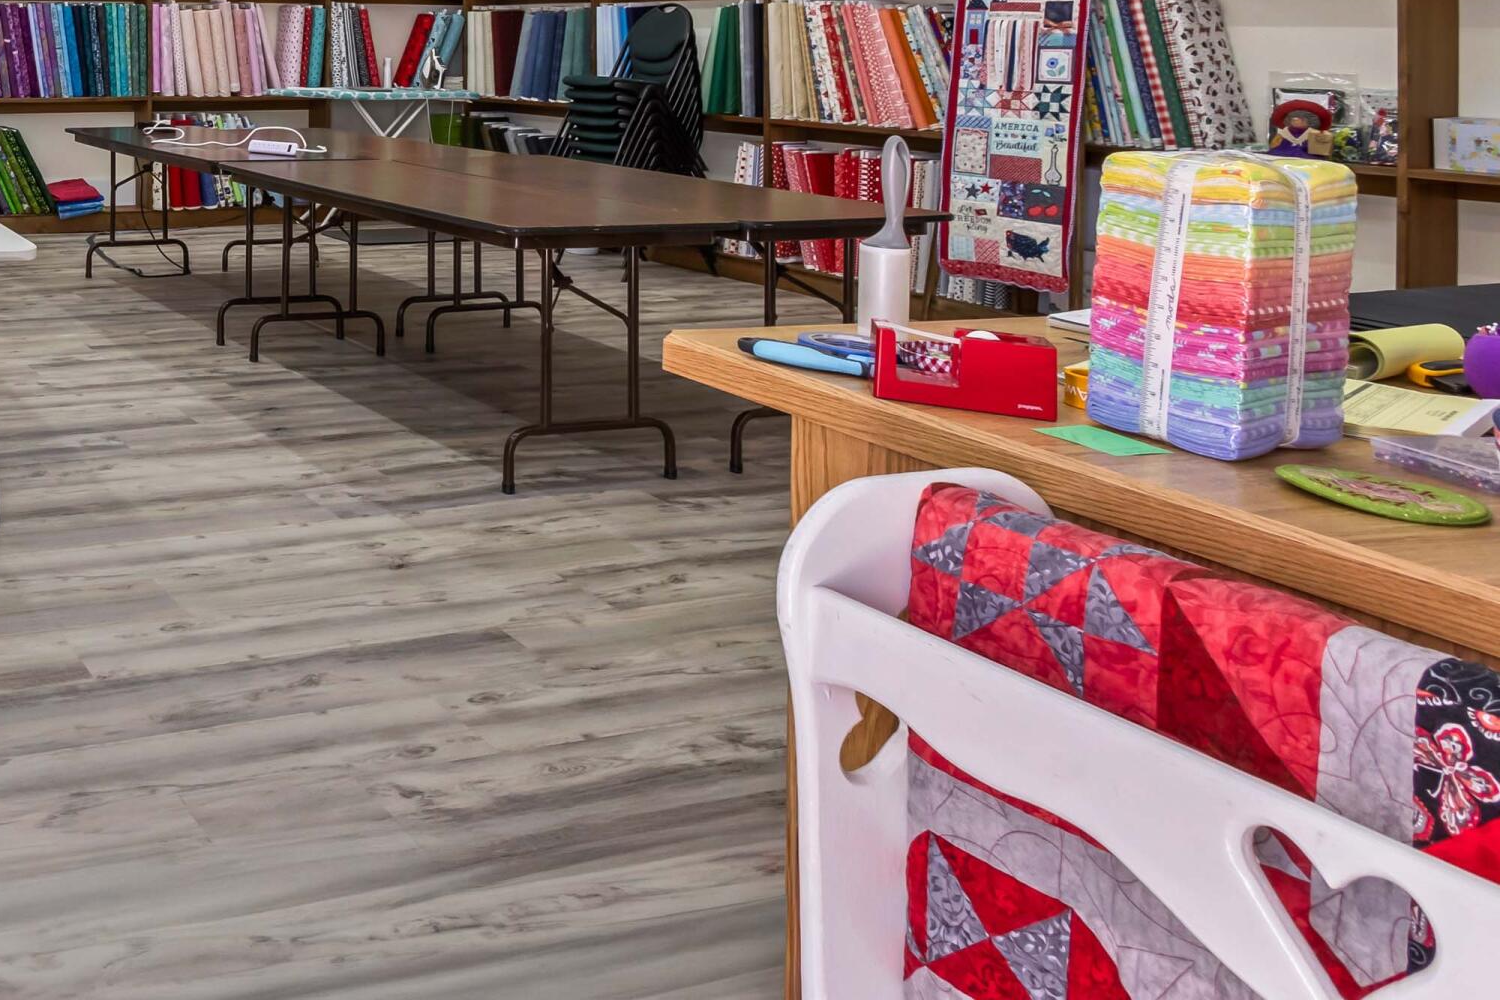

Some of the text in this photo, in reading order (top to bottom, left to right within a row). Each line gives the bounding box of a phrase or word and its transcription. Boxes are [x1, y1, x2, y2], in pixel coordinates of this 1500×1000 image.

[994, 122, 1039, 132] AMERICA
[995, 140, 1038, 152] Beautiful
[1165, 277, 1177, 330] moda
